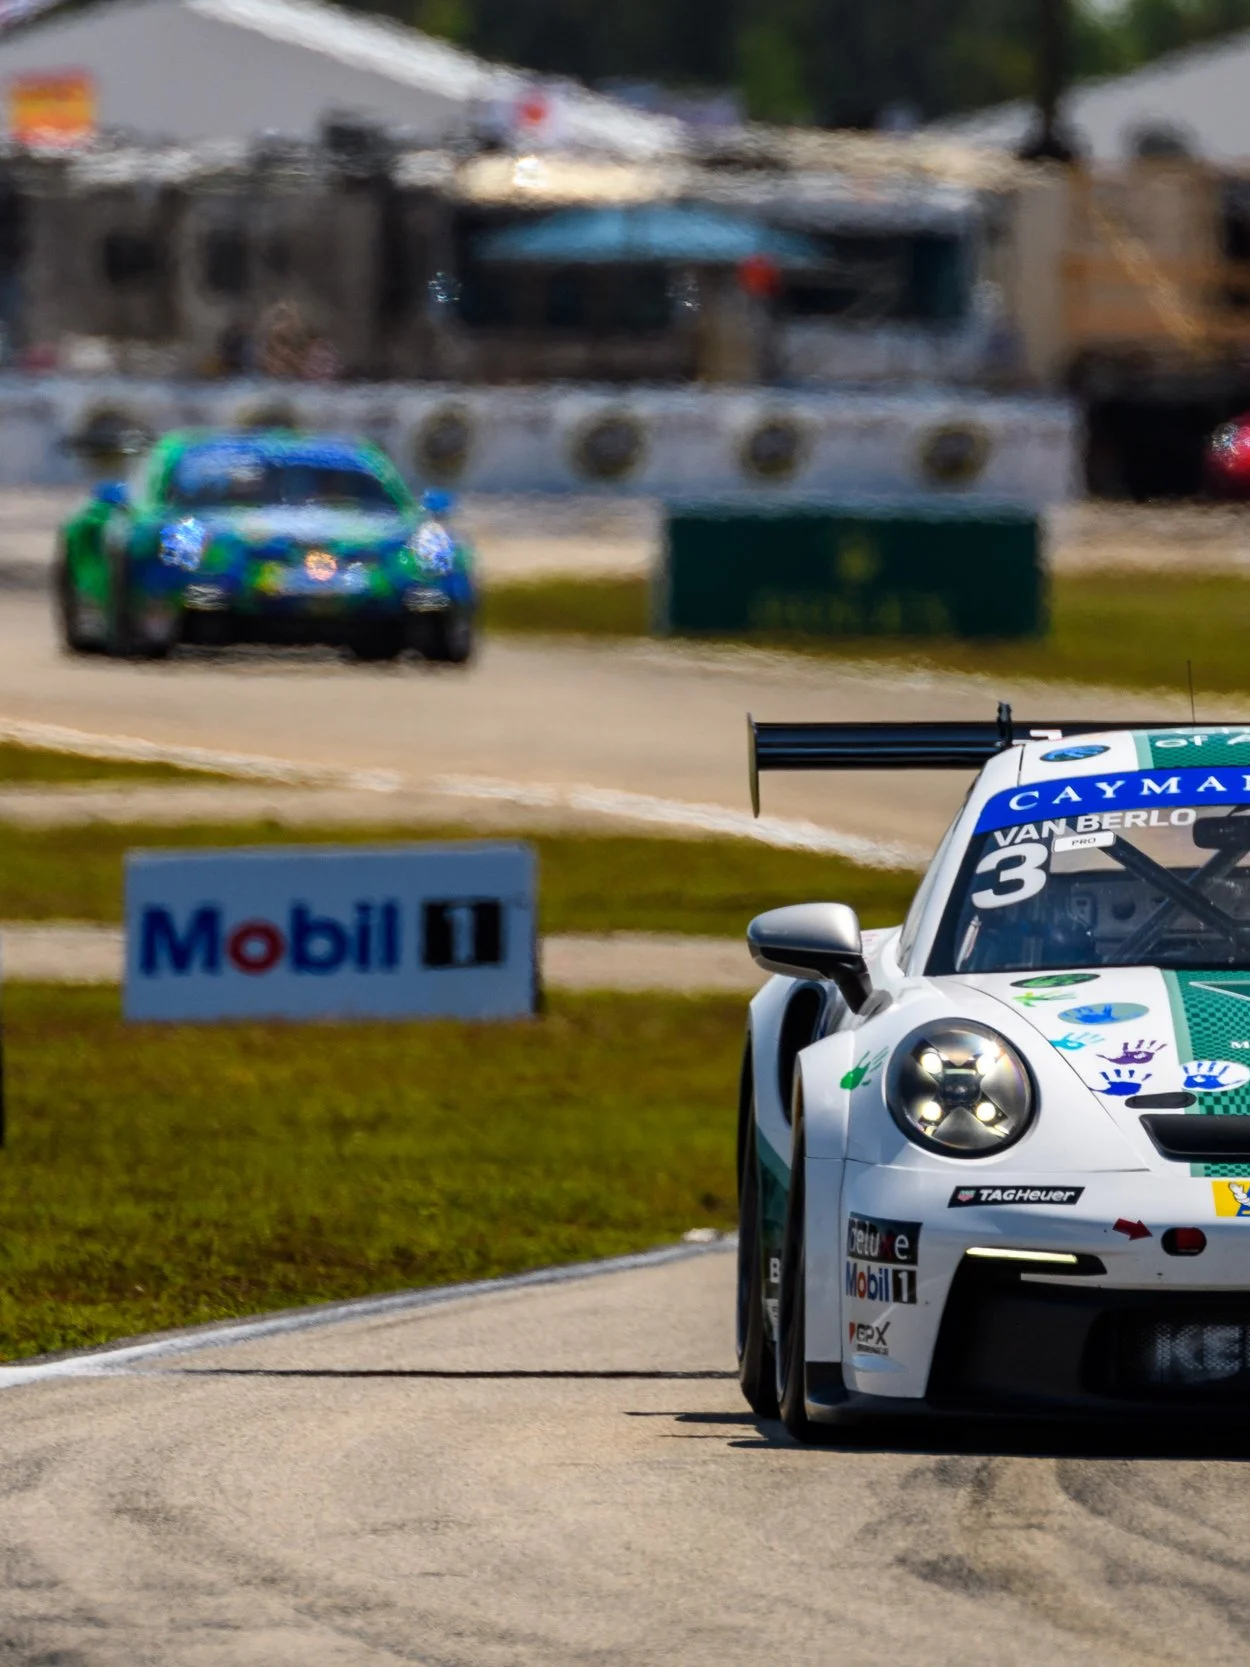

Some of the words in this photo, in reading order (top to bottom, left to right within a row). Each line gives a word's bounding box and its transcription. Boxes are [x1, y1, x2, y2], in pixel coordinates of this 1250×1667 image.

[1154, 734, 1208, 748] of
[994, 818, 1066, 847] VAN
[1076, 809, 1197, 833] BERLO
[1071, 837, 1096, 846] PRO
[971, 842, 1049, 909] 3
[139, 898, 400, 976] Mobil
[979, 1189, 1075, 1202] TAGHeuer
[846, 1260, 890, 1303] Mobil
